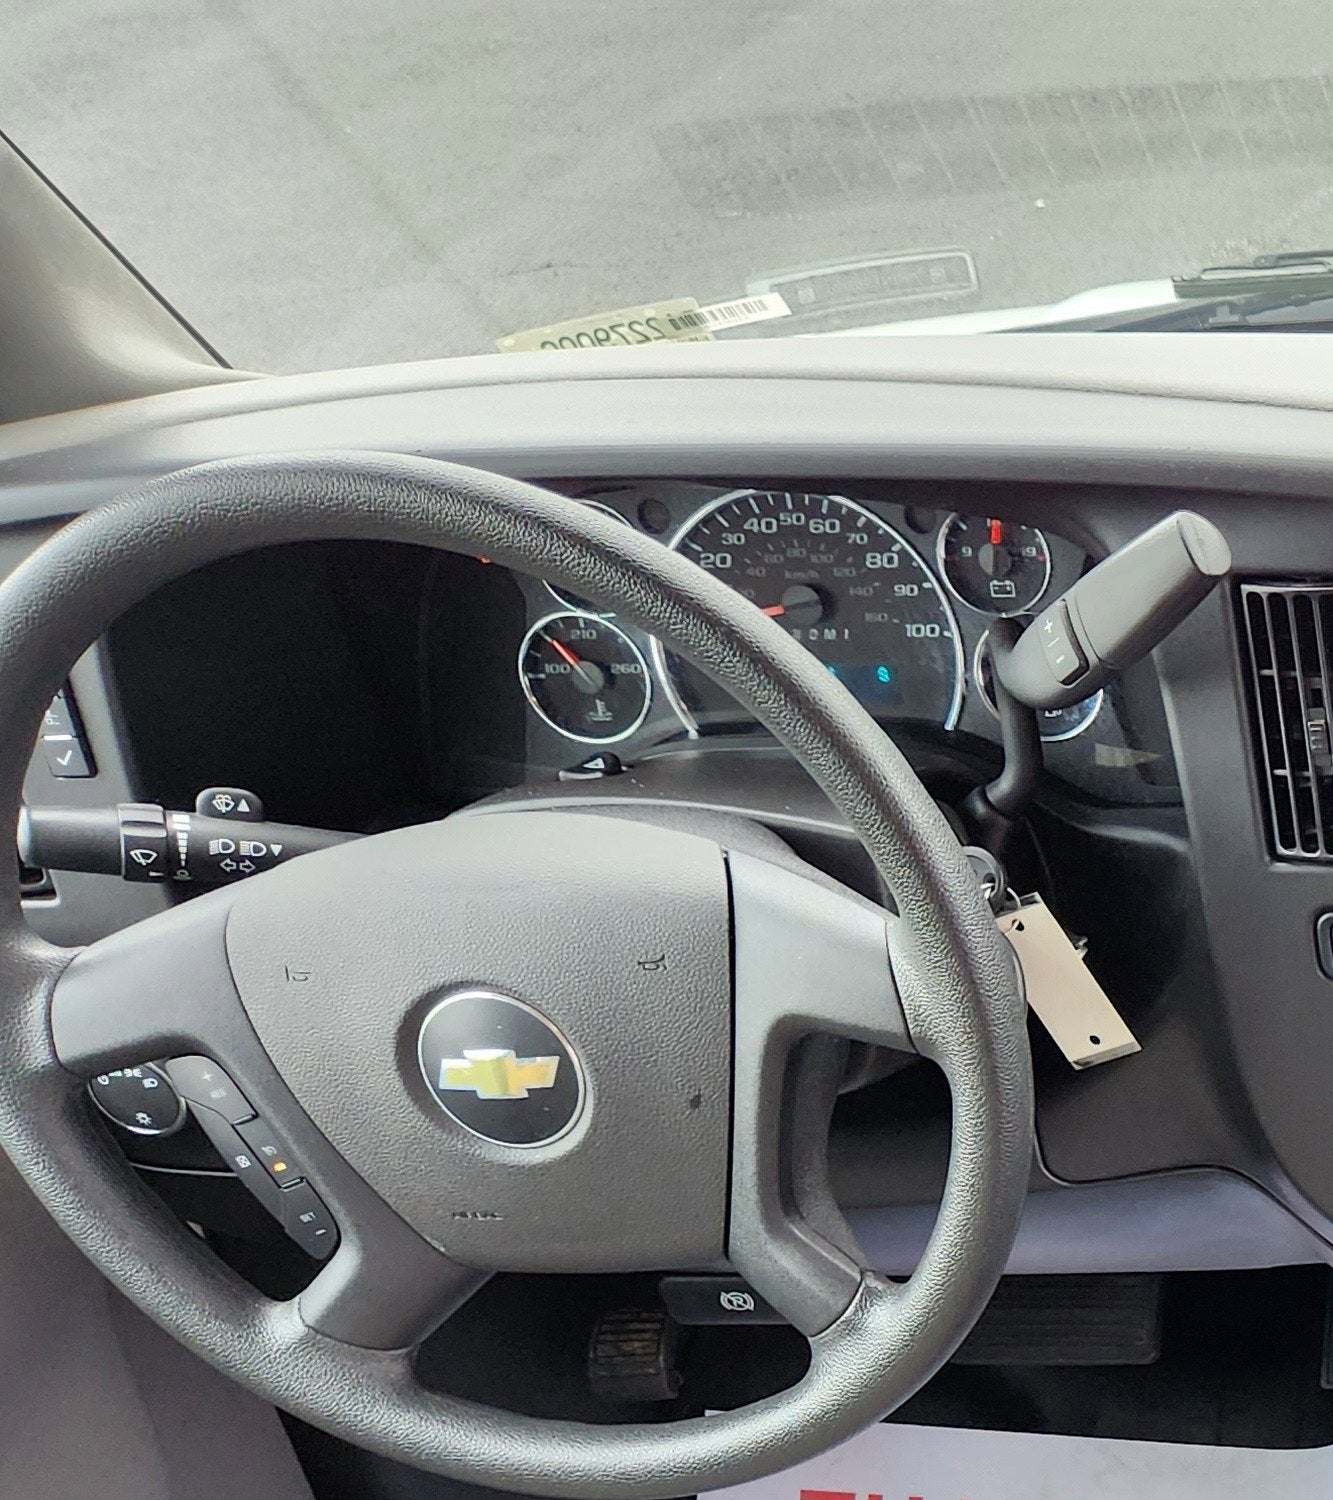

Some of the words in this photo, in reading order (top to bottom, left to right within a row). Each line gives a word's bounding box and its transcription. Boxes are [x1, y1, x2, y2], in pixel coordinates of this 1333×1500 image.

[779, 512, 805, 526] 50
[743, 518, 777, 534] 40
[809, 518, 841, 534] 60
[721, 533, 745, 545] 30
[846, 533, 868, 545] 70
[961, 546, 972, 557] 9
[700, 552, 732, 569] 20
[866, 552, 898, 569] 80
[893, 584, 919, 597] 90
[570, 629, 597, 640] 210
[905, 623, 941, 638] 100
[544, 663, 571, 674] 100
[611, 663, 642, 674] 260
